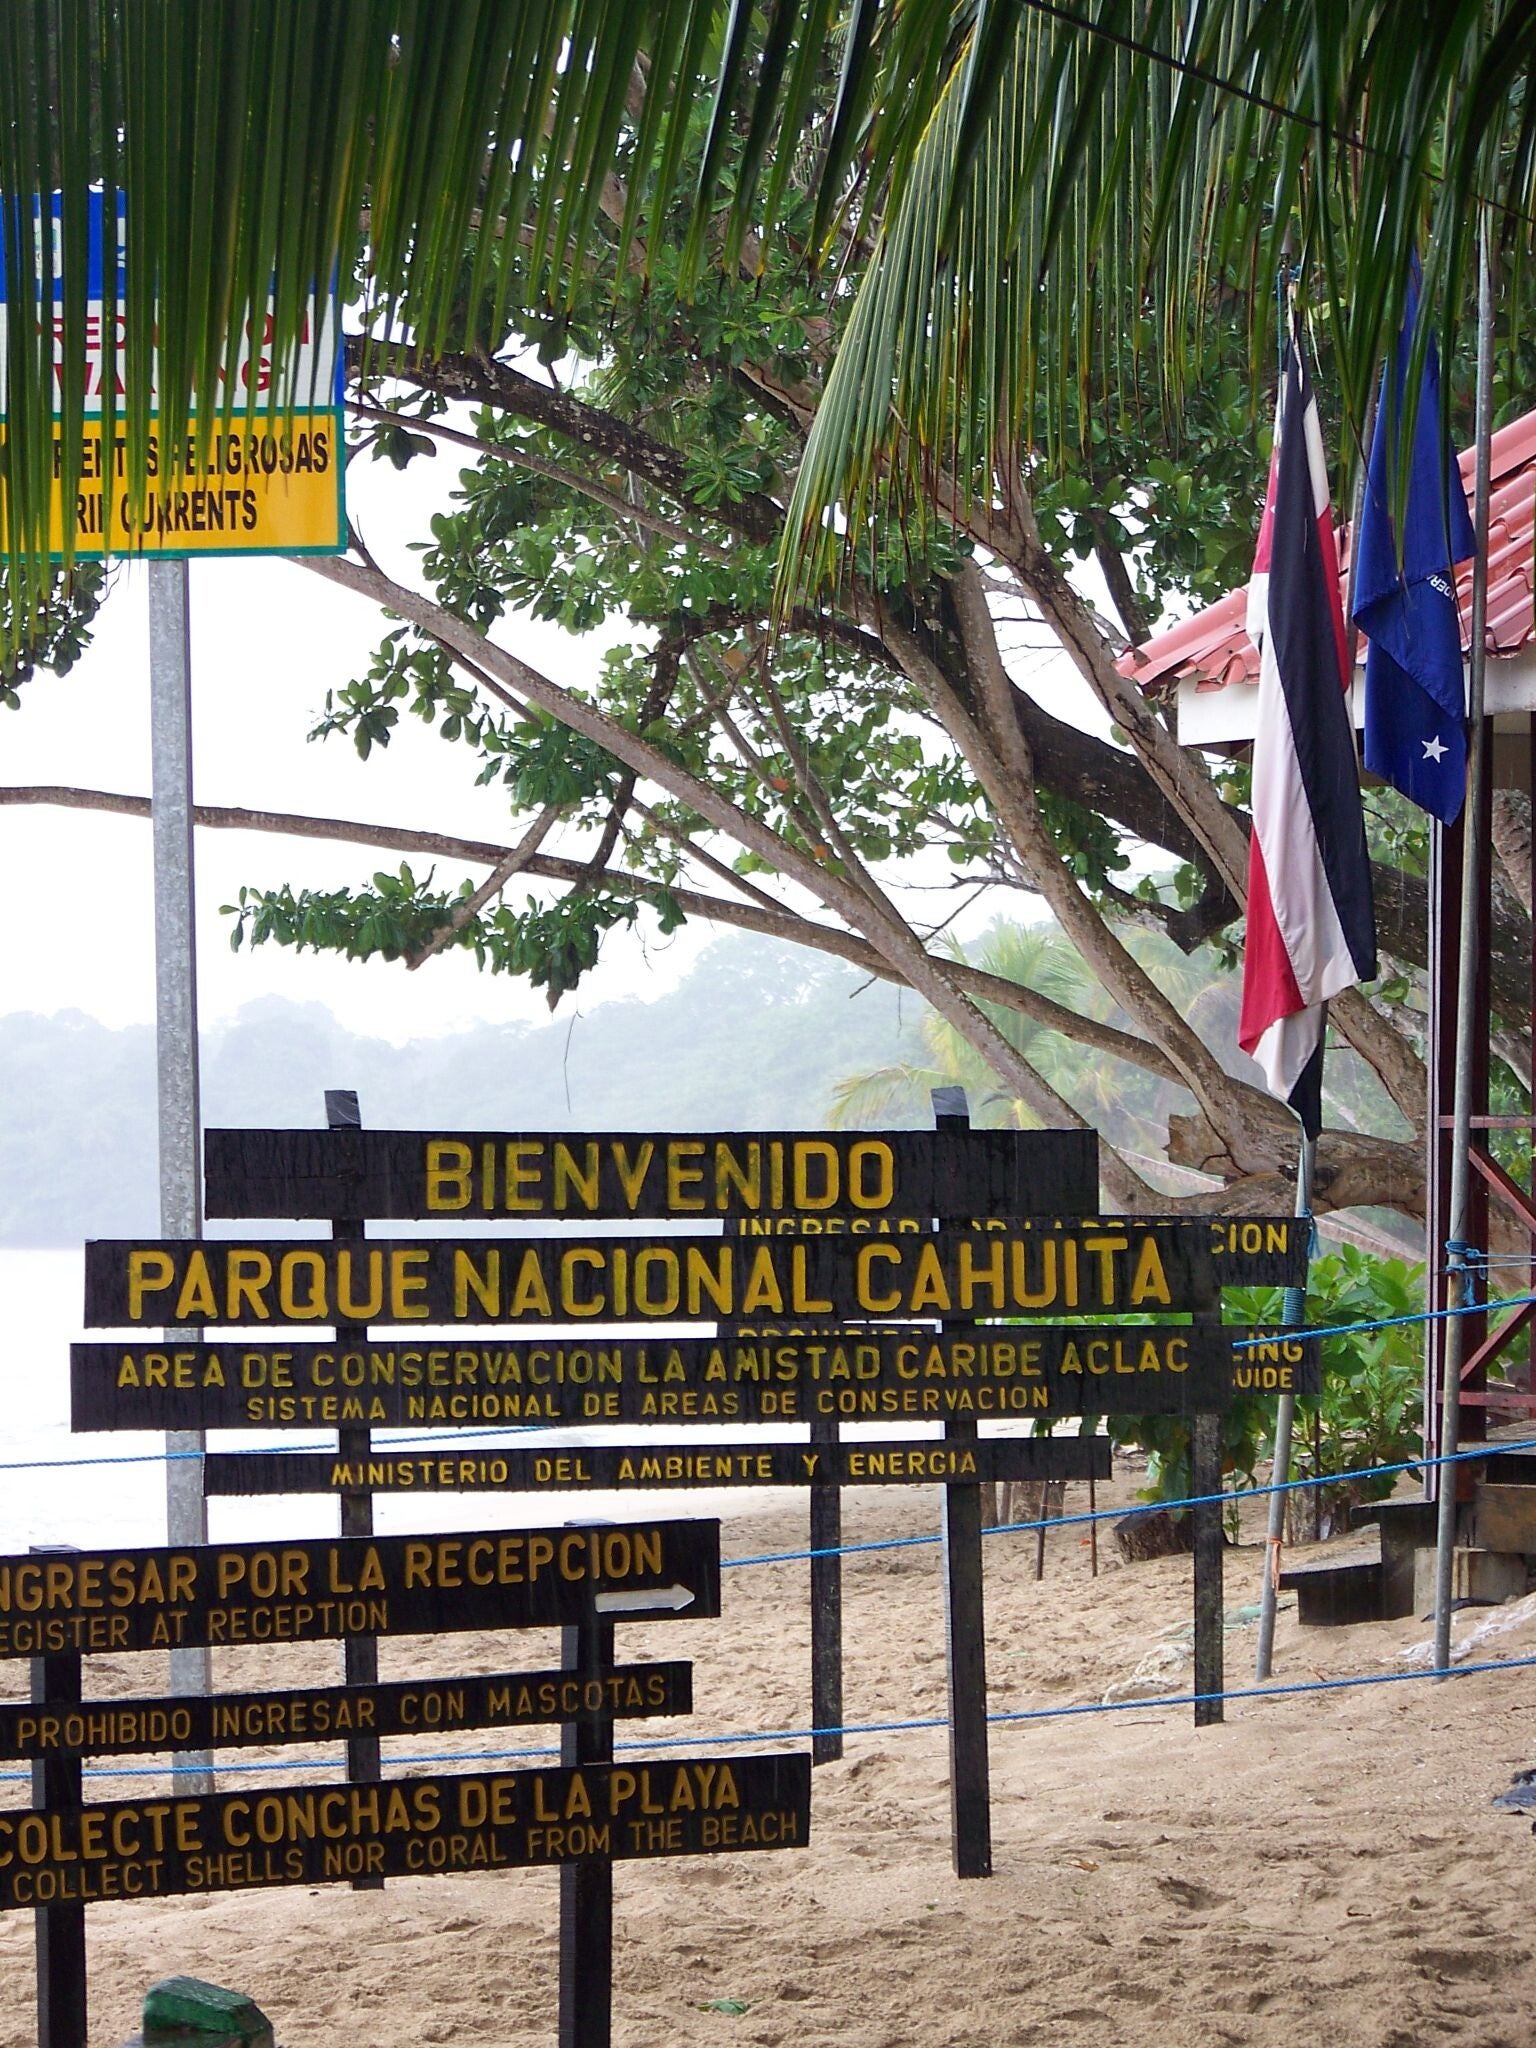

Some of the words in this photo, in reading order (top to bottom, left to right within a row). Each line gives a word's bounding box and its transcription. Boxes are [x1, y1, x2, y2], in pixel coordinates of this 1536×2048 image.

[426, 1140, 894, 1210] BIENVENIDO
[128, 1249, 429, 1319] PARQUE
[454, 1245, 833, 1317] NACIONAL
[857, 1236, 1172, 1314] CAHUITA
[117, 1353, 225, 1388] AREA
[242, 1353, 293, 1387] DE
[312, 1350, 622, 1386] CONSERVACION
[639, 1350, 685, 1383] LA
[705, 1345, 880, 1381] AMISTAD
[896, 1342, 1040, 1380] CARIBE
[1061, 1338, 1189, 1374] ACLAC
[248, 1395, 386, 1420] SISTEMA
[408, 1393, 560, 1418] NACIONAL
[584, 1392, 618, 1416] DE
[642, 1391, 738, 1415] AREAS
[761, 1390, 795, 1414] DE
[817, 1386, 1048, 1413] CONSERVACION
[331, 1458, 508, 1485] MINISTERIO
[535, 1458, 591, 1481] DEL
[618, 1454, 772, 1479] AMBIENTE
[802, 1454, 818, 1476] Y
[848, 1450, 976, 1476] ENERGIA
[219, 1550, 309, 1597] POR
[330, 1547, 385, 1593] LA
[406, 1531, 662, 1588] RECEPCION
[152, 1611, 186, 1641] AT
[208, 1600, 388, 1641] RECEPTION
[18, 1709, 190, 1746] PROHIBIDO
[213, 1699, 374, 1734] INGRESAR
[401, 1693, 463, 1723] CON
[488, 1675, 665, 1716] MASCOTAS
[223, 1785, 440, 1847] CONCHAS
[460, 1779, 516, 1827] DE
[535, 1774, 591, 1821] LA
[611, 1765, 739, 1815] PLAYA
[13, 1859, 163, 1902] COLLECT
[186, 1850, 303, 1887] SHELLS
[325, 1842, 384, 1873] NOR
[406, 1833, 507, 1868] CORAL
[528, 1826, 609, 1856] FROM
[630, 1819, 682, 1850] THE
[703, 1812, 797, 1846] BEACH
